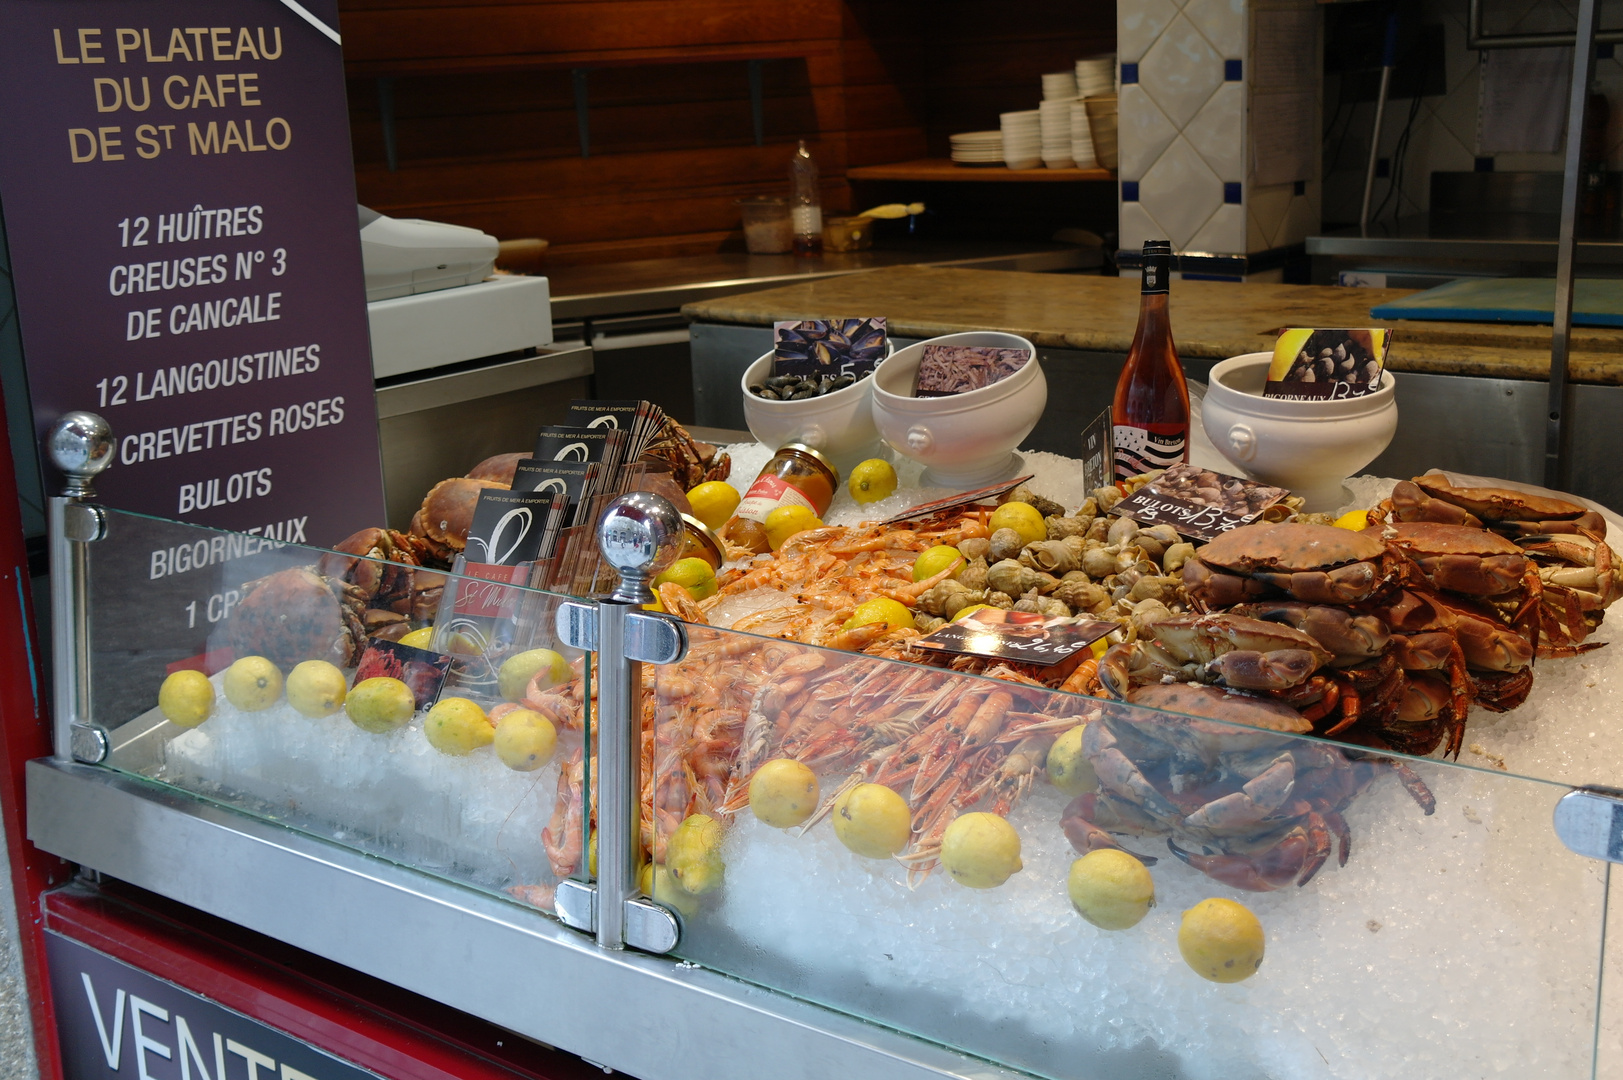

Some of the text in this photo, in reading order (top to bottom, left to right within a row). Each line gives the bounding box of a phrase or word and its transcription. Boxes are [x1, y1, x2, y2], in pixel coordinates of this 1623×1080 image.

[53, 26, 283, 64] LE PLATEAU
[94, 73, 262, 113] DU CAFE
[68, 126, 125, 163] DE
[188, 117, 292, 156] MALO
[118, 203, 264, 248] 12 HUÎTRES
[109, 247, 287, 296] CREUSES N° 3
[126, 292, 282, 341] DE CANCALE
[96, 343, 321, 408] 12 LANGOUSTINES
[120, 411, 263, 466] CREVETTES
[269, 396, 345, 437] ROSES
[179, 467, 272, 514] BULOTS
[1132, 495, 1192, 517] BULOTS
[150, 516, 308, 580] BIGORNEAUX
[185, 600, 196, 629] 1
[81, 972, 319, 1080] VENT
